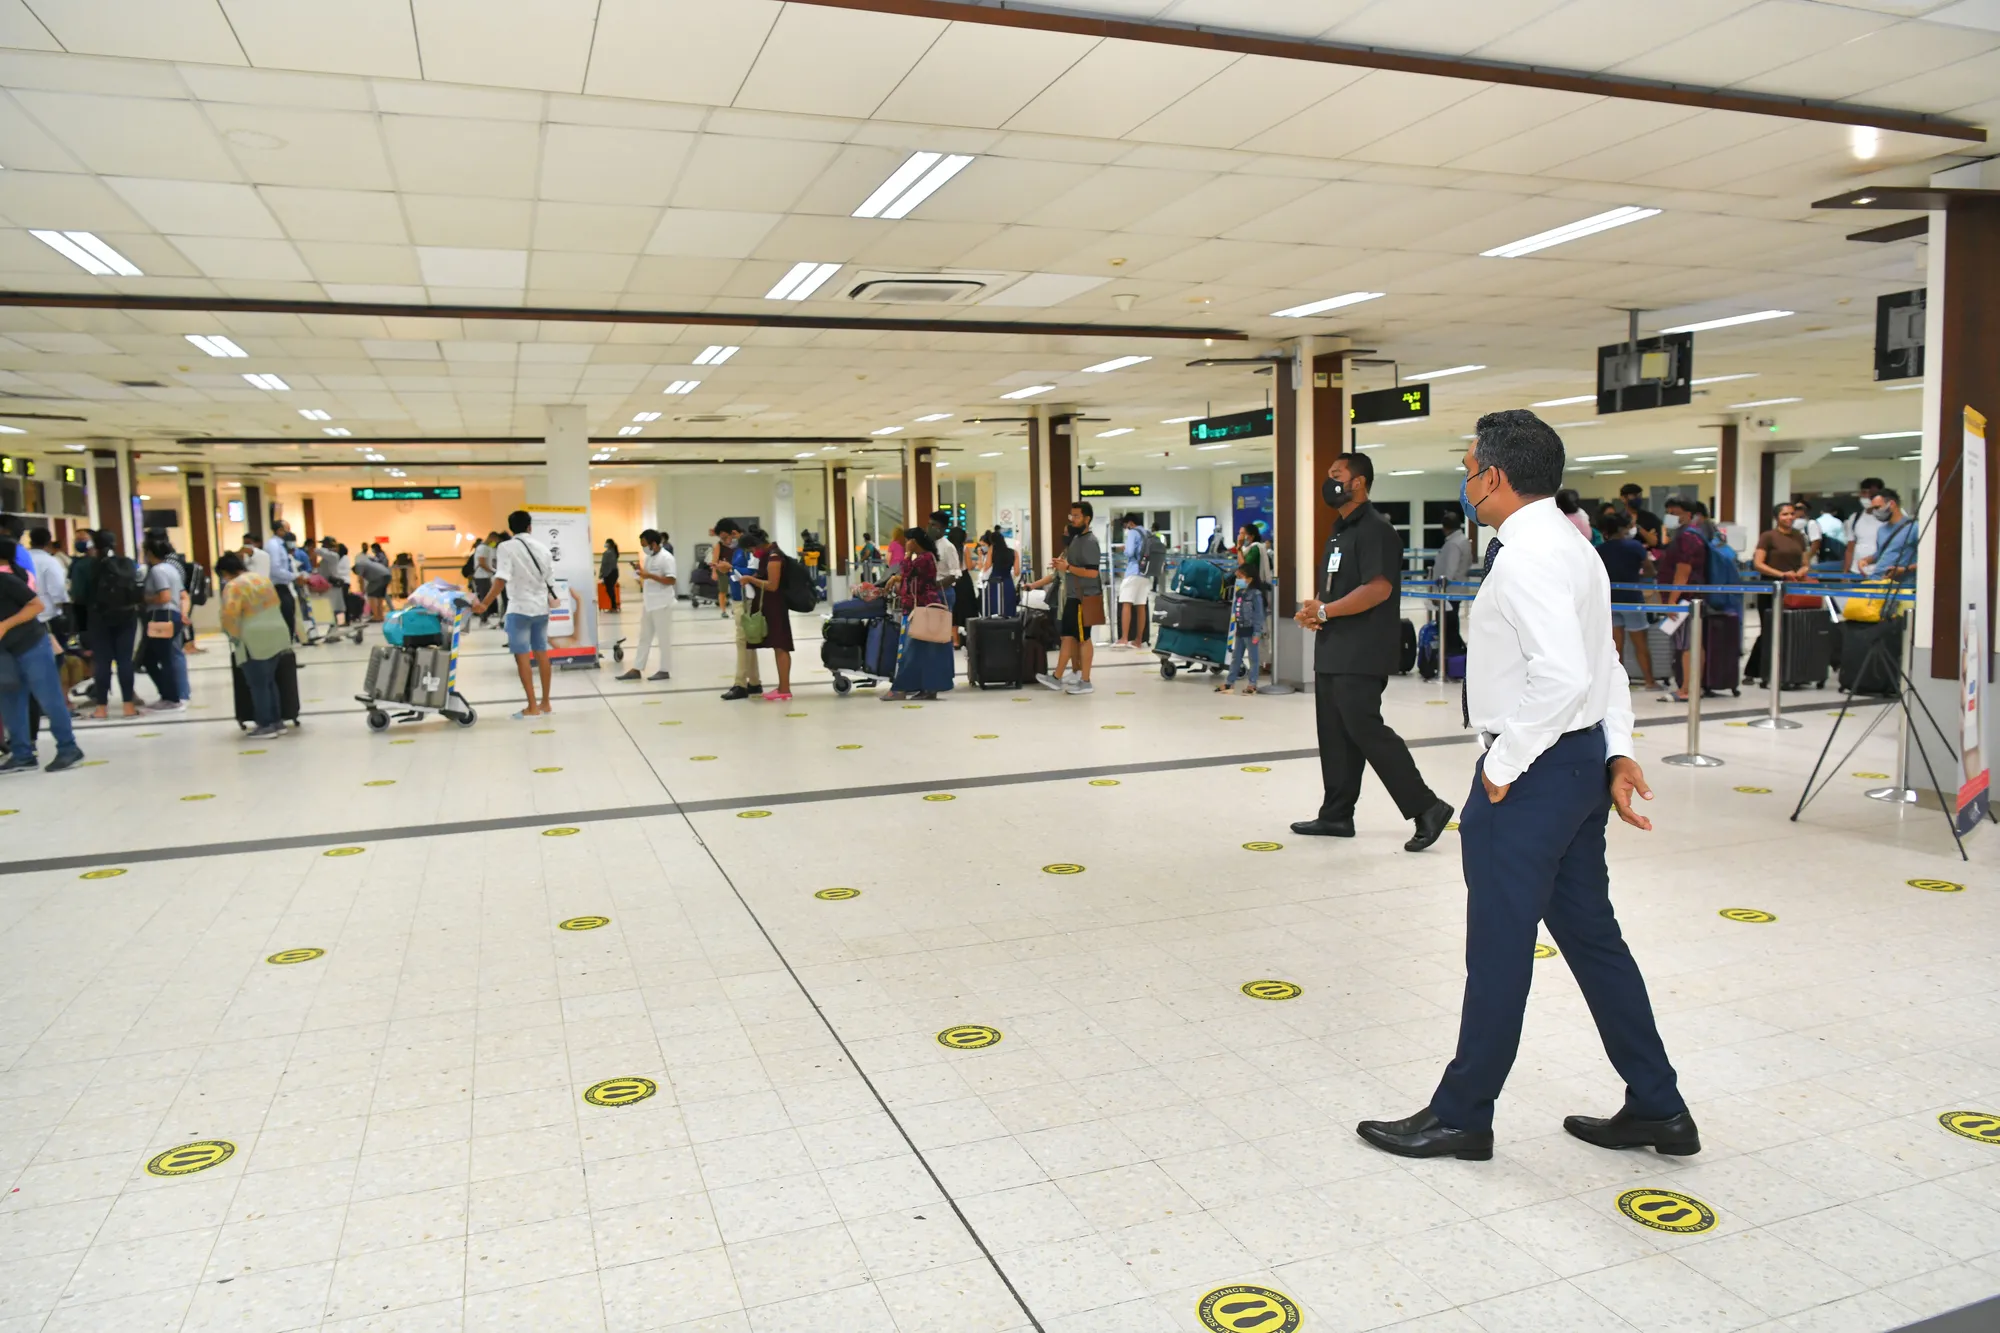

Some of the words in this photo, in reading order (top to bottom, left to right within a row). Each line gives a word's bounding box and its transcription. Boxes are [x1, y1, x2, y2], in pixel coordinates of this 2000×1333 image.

[1621, 1190, 1652, 1204] DISTANCE
[1622, 1204, 1645, 1222] SOCIAL
[1645, 1221, 1673, 1231] KEEP
[1676, 1221, 1709, 1232] PLEASE
[1205, 1287, 1246, 1304] DISTANCE
[1262, 1290, 1285, 1303] HERE
[1202, 1305, 1218, 1327] SOCIAL
[1284, 1304, 1297, 1323] STAND
